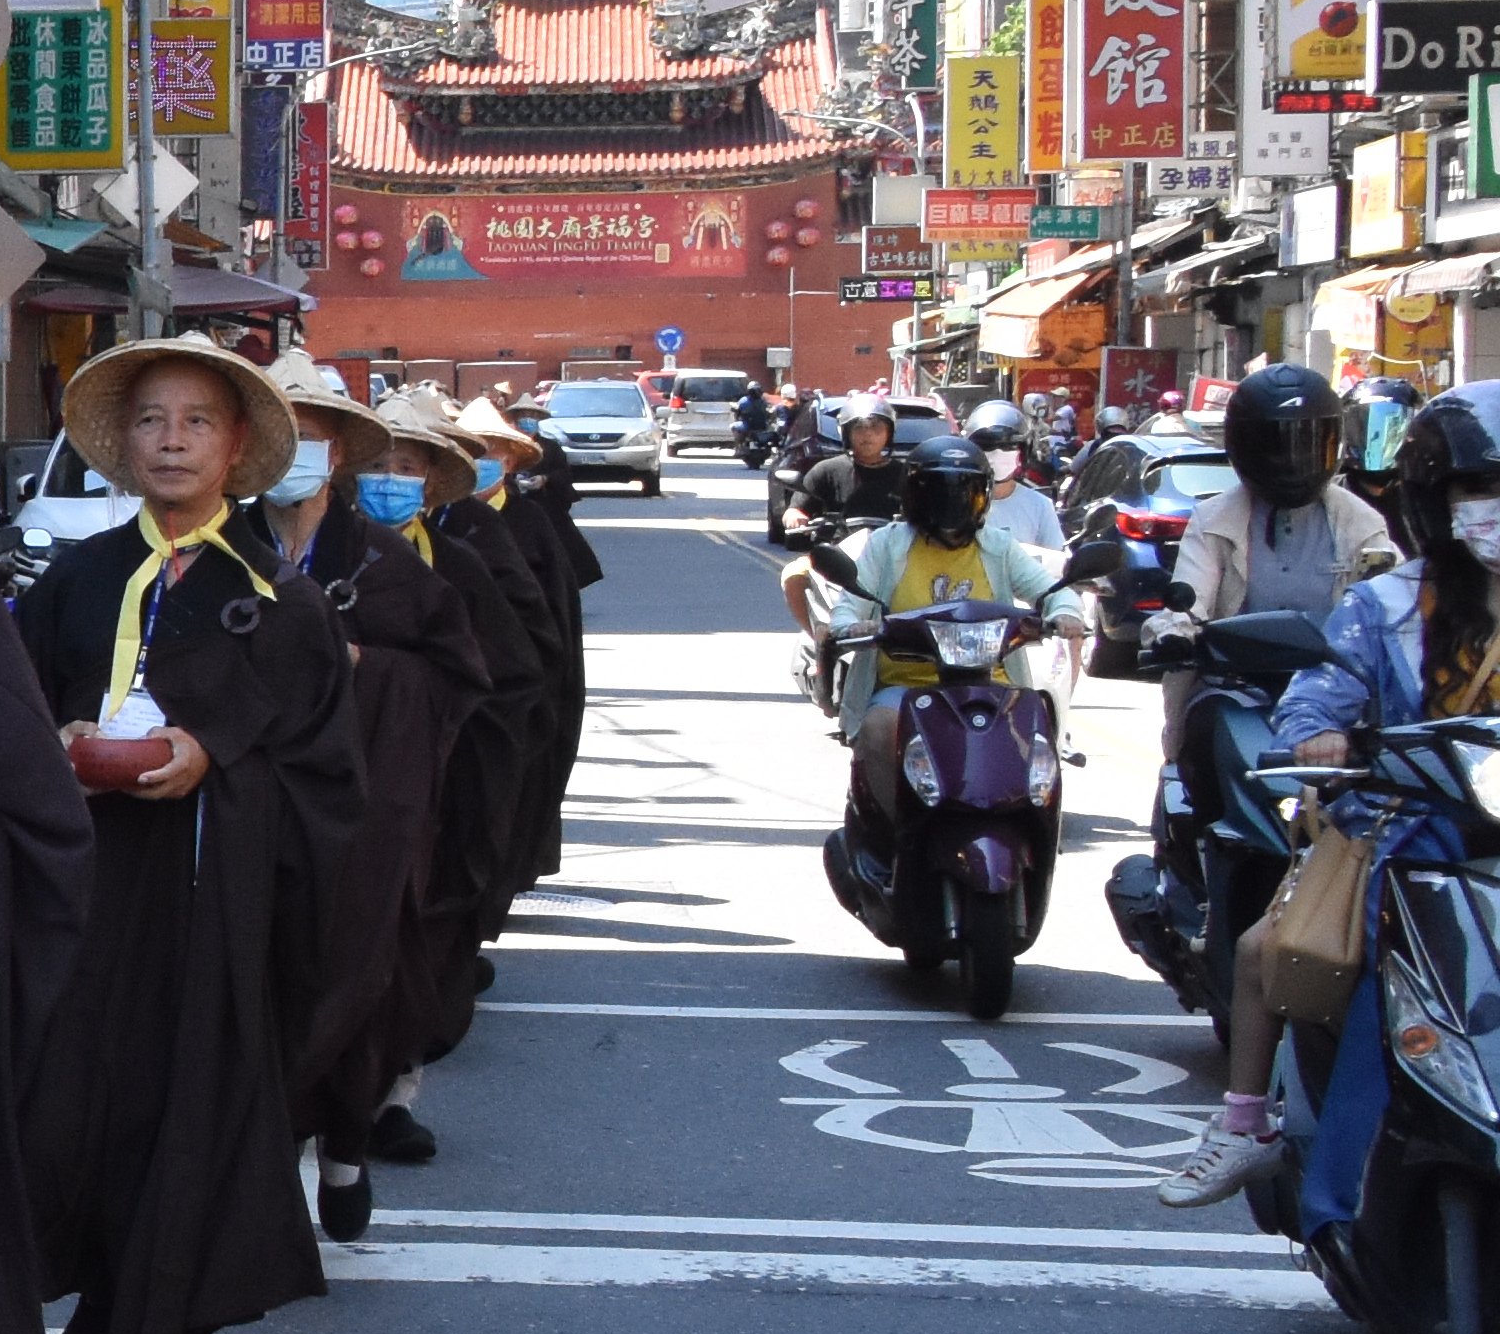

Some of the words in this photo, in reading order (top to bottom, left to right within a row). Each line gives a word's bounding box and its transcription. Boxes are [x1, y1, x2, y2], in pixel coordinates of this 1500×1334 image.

[86, 17, 108, 146] 冰品瓜子
[246, 40, 323, 68] 中正店
[1381, 26, 1445, 70] Do
[60, 17, 82, 148] 糖果餅乾
[968, 70, 1000, 160] 天鵝公主
[1091, 122, 1177, 150] 中正店
